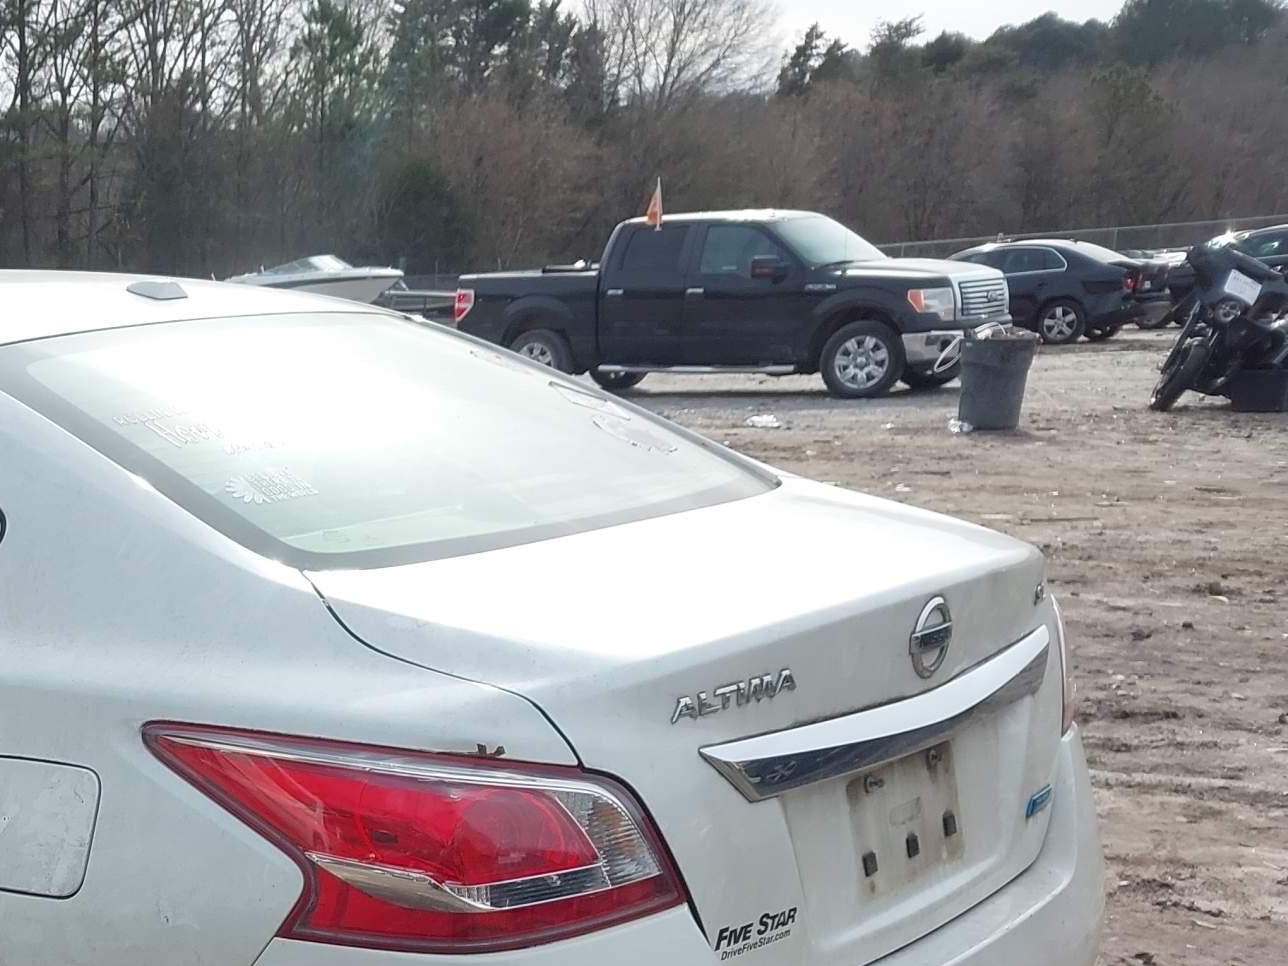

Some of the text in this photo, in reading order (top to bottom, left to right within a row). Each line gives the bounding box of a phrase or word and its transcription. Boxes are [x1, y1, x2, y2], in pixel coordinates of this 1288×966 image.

[671, 667, 797, 725] ALTIMA
[714, 906, 798, 952] FIVE STAR
[720, 929, 792, 961] DriveFiveStar.com
